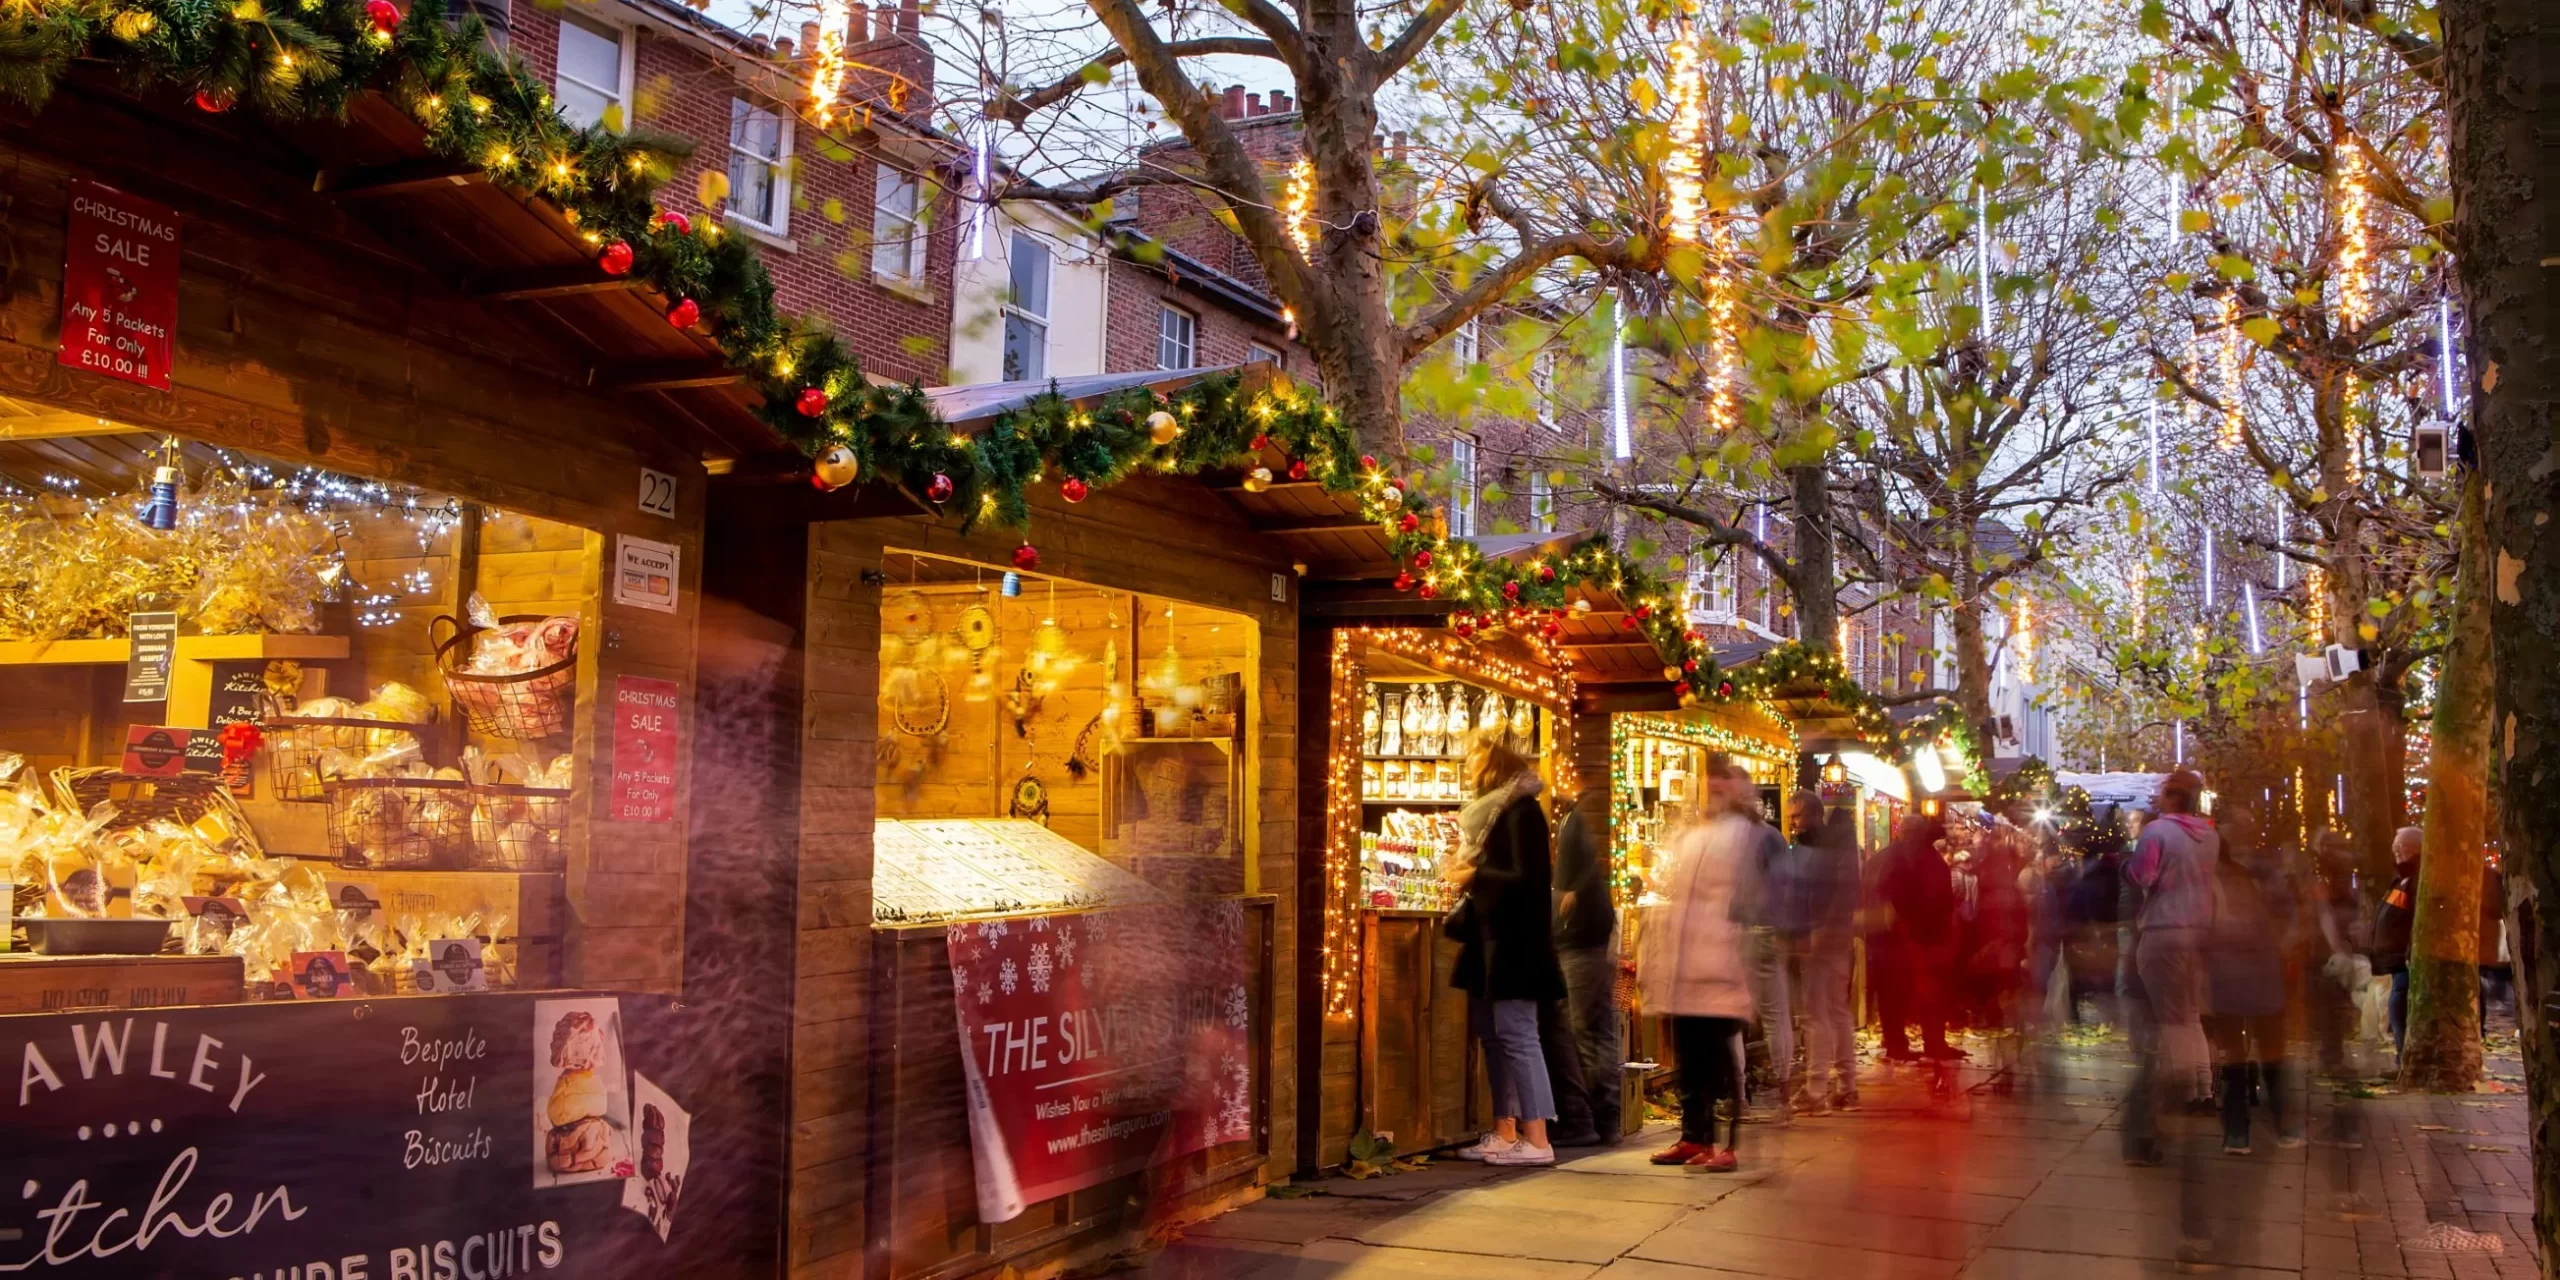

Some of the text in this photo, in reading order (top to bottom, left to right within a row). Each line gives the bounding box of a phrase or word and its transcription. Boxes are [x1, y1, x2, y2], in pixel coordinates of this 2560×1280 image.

[73, 197, 175, 242] CHRISTMAS
[94, 234, 150, 267] SALE
[71, 302, 165, 339] Any 5 Packets
[87, 327, 145, 357] For Only
[81, 350, 148, 379] £10.00 !!!
[641, 473, 671, 513] 22
[627, 553, 669, 571] WE ACCEPT
[1273, 575, 1284, 599] 21
[153, 632, 167, 640] LOVE
[232, 672, 262, 681] SAWLE
[228, 705, 236, 715] A
[237, 705, 252, 716] Box
[618, 690, 676, 708] CHRISTMAS
[630, 714, 662, 733] SALE
[617, 770, 670, 784] Any 5 Packets
[626, 787, 659, 803] For Only
[400, 1026, 487, 1072] Bespoke
[983, 1016, 1048, 1077] THE
[1058, 1007, 1142, 1066] SILVER
[416, 1075, 476, 1116] Hotel
[1035, 1101, 1071, 1121] Wishes
[1072, 1095, 1089, 1113] You
[1091, 1097, 1100, 1108] a
[1100, 1087, 1121, 1107] Very
[1047, 1107, 1171, 1155] www.thesilverguru.com
[403, 1126, 492, 1170] Biscuits
[389, 1220, 564, 1280] BISCUITS
